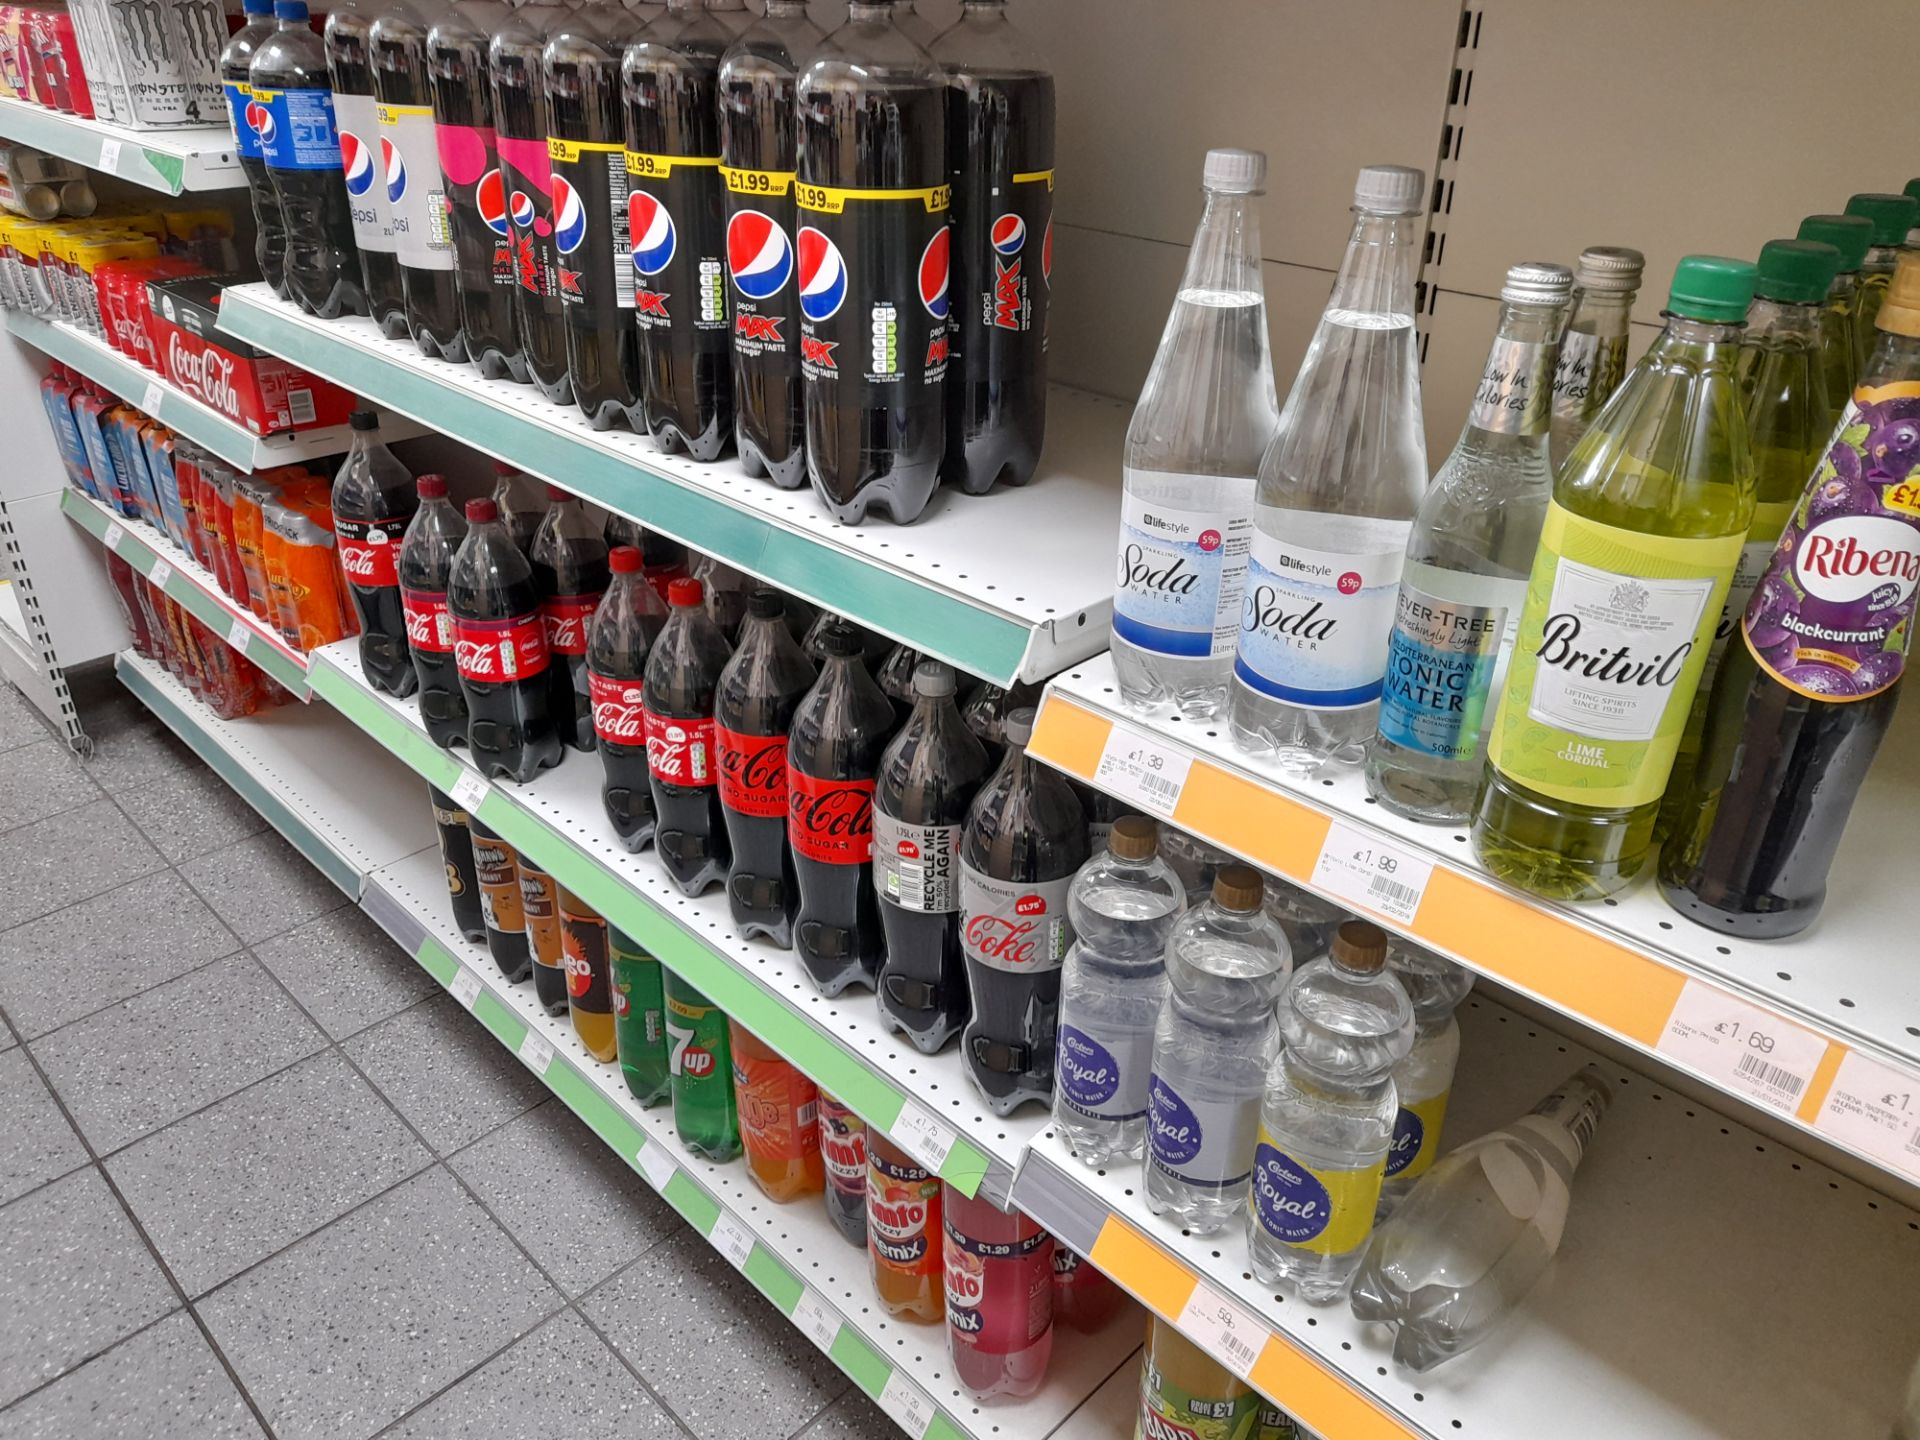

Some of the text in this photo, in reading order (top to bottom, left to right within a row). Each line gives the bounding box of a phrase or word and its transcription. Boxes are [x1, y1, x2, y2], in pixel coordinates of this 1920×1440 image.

[186, 100, 200, 119] 4
[627, 156, 667, 175] £1.99 RRP
[729, 170, 784, 193] £1.99 RRP
[797, 185, 840, 210] £1.99 RRP
[351, 208, 377, 224] epsi
[994, 254, 1021, 331] MAX
[736, 302, 756, 313] pepsi
[982, 293, 993, 326] pepsi
[654, 315, 671, 328] TASTE
[735, 312, 786, 342] MAX
[735, 337, 786, 352] MAXIMUM TASTE
[743, 347, 761, 357] sugar
[820, 370, 838, 380] TASTE
[1483, 360, 1529, 388] Low In
[1571, 358, 1588, 378] In
[1152, 517, 1190, 534] lifestyle
[1202, 535, 1219, 546] 59p
[1142, 546, 1179, 558] SPARKLING
[1803, 535, 1920, 581] Ribena
[1116, 544, 1200, 594] Soda
[1290, 557, 1332, 576] lifestyle
[1130, 583, 1182, 604] WATER
[1340, 577, 1359, 590] 59p
[1276, 587, 1316, 603] SPARKLING
[1871, 586, 1893, 602] juicy
[1241, 585, 1338, 641] Soda
[1400, 594, 1496, 633] EVER-TREE
[1867, 602, 1885, 612] since
[1781, 612, 1885, 643] blackcurrant
[1259, 627, 1317, 651] WATER
[1448, 631, 1480, 649] Light
[1394, 637, 1475, 673] MEDITERRANEAN
[1823, 652, 1850, 666] vitamin
[1392, 651, 1464, 691] TONIC
[598, 681, 624, 692] TASTE
[1388, 670, 1464, 713] WATER
[1564, 687, 1637, 709] LIFTING SPIRITS
[1572, 698, 1625, 715] SINCE 1938
[646, 715, 666, 729] TASTE
[1432, 743, 1462, 755] 500ml
[1567, 741, 1607, 759] LIME
[1128, 749, 1164, 771] £1.39
[1557, 750, 1610, 769] CORDIAL
[724, 784, 787, 803] ERO SUGAR
[896, 826, 911, 838] 1.75L
[807, 836, 849, 850] SUGAR
[937, 829, 950, 878] AGAIN
[1353, 849, 1398, 874] £1.99
[924, 829, 935, 911] RECYCLE ME
[977, 880, 1016, 897] CALORIES
[966, 914, 1040, 963] Coke
[1714, 1021, 1775, 1054] £1.69
[666, 1021, 695, 1077] 7
[685, 1053, 711, 1073] up
[1060, 1043, 1107, 1085] Royal
[1881, 1093, 1913, 1116] £1.
[1148, 1092, 1189, 1143] Royal
[890, 1165, 928, 1179] £1.29
[921, 1186, 939, 1197] NEW
[1256, 1164, 1317, 1219] Royal
[876, 1221, 902, 1237] fizzy
[1265, 1217, 1311, 1237] TONIC WATER
[871, 1226, 921, 1260] Remix
[978, 1244, 1010, 1255] £1.29
[950, 1309, 980, 1331] mix
[1217, 1306, 1236, 1330] 59p
[1213, 1401, 1235, 1418] £1
